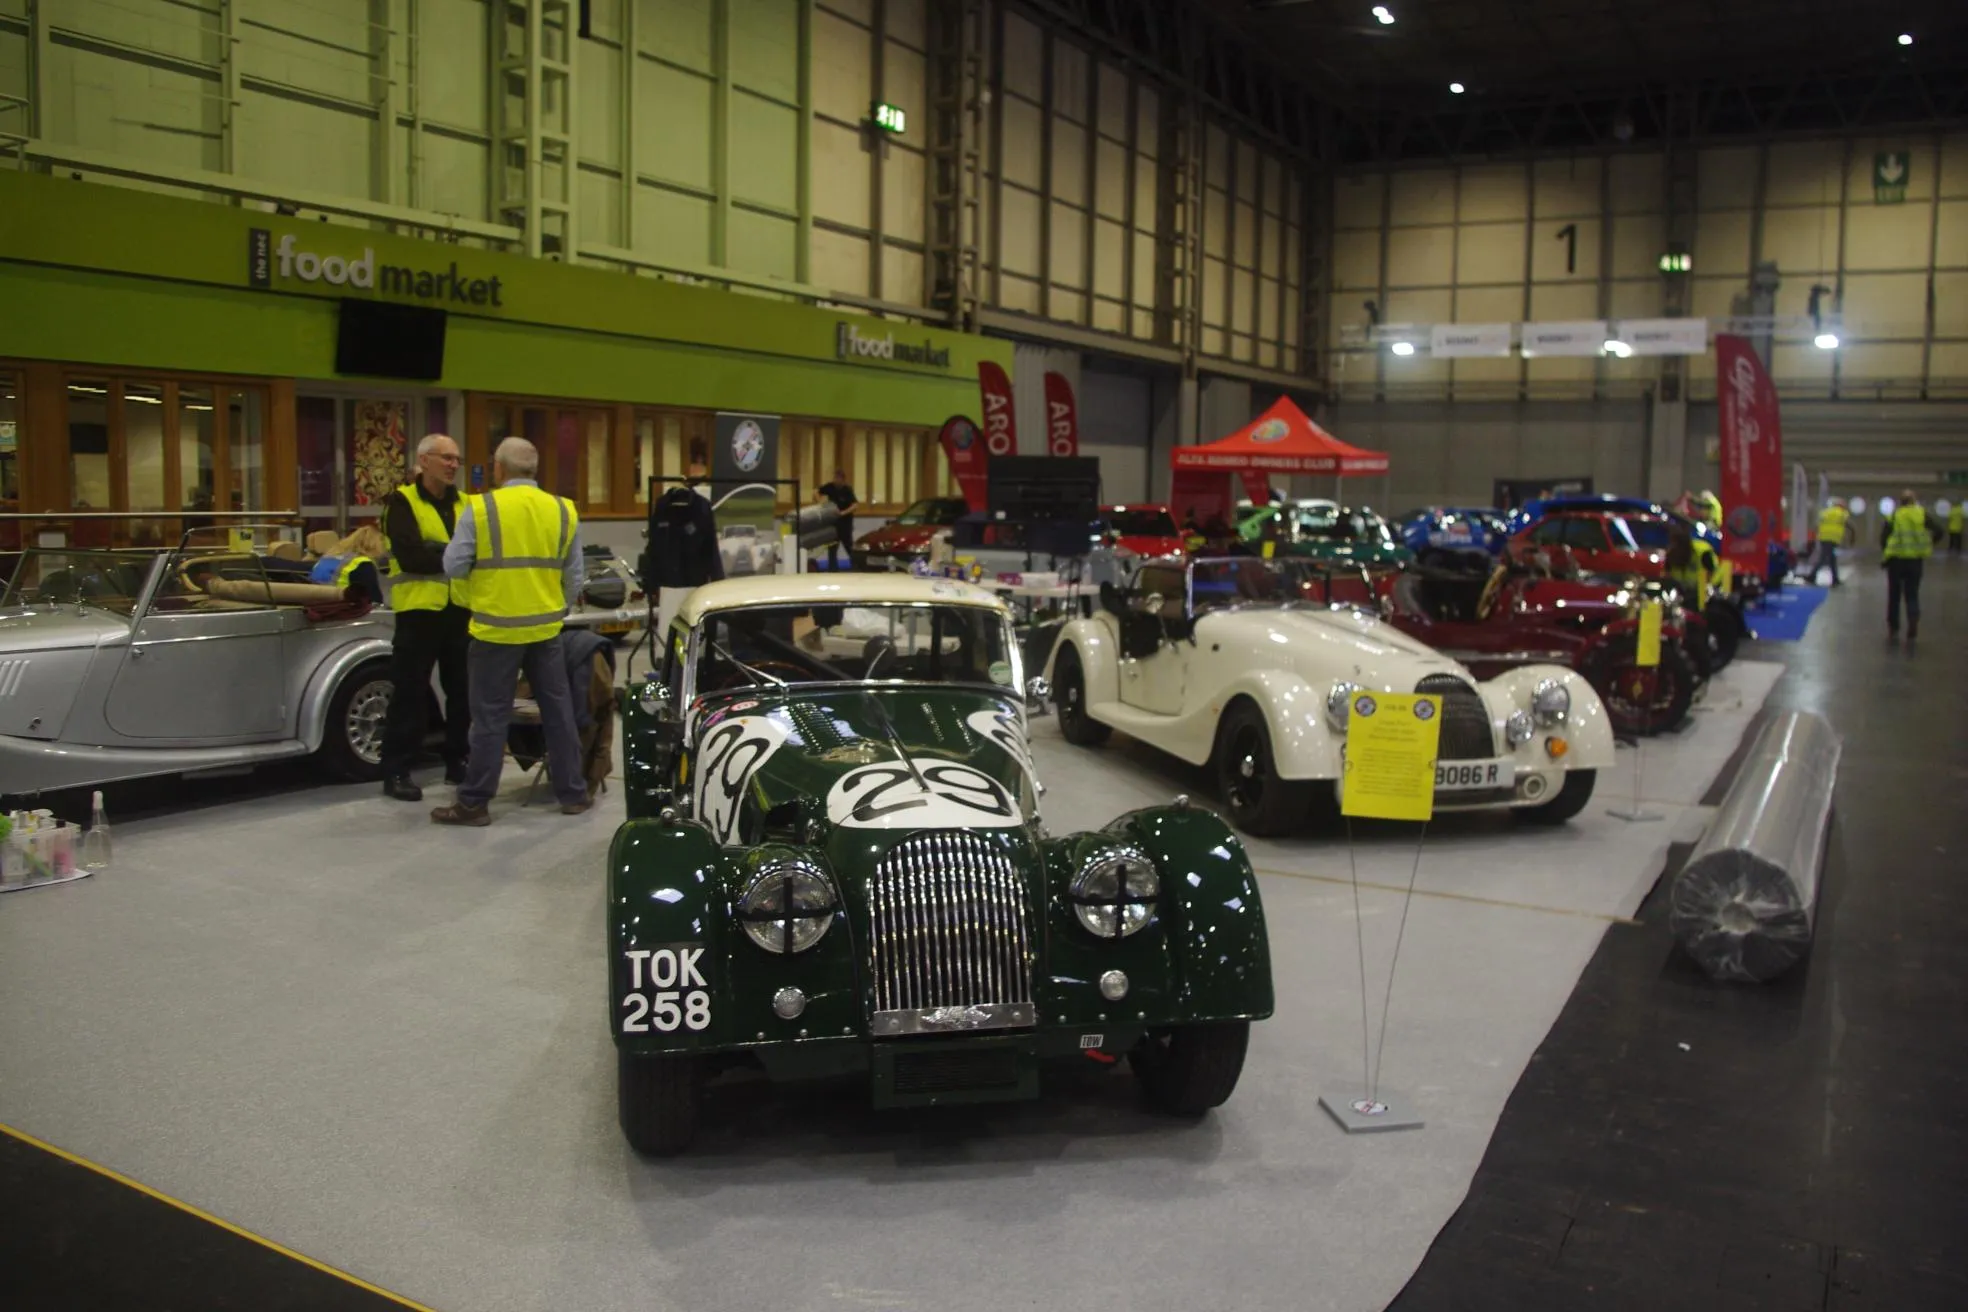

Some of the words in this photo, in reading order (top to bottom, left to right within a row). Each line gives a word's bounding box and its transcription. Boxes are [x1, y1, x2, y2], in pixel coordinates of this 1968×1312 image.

[1556, 224, 1576, 274] 1
[276, 234, 374, 289] food
[380, 262, 503, 307] market
[849, 325, 893, 360] food
[1487, 764, 1498, 783] R
[624, 947, 707, 989] TOK
[622, 990, 712, 1033] 258
